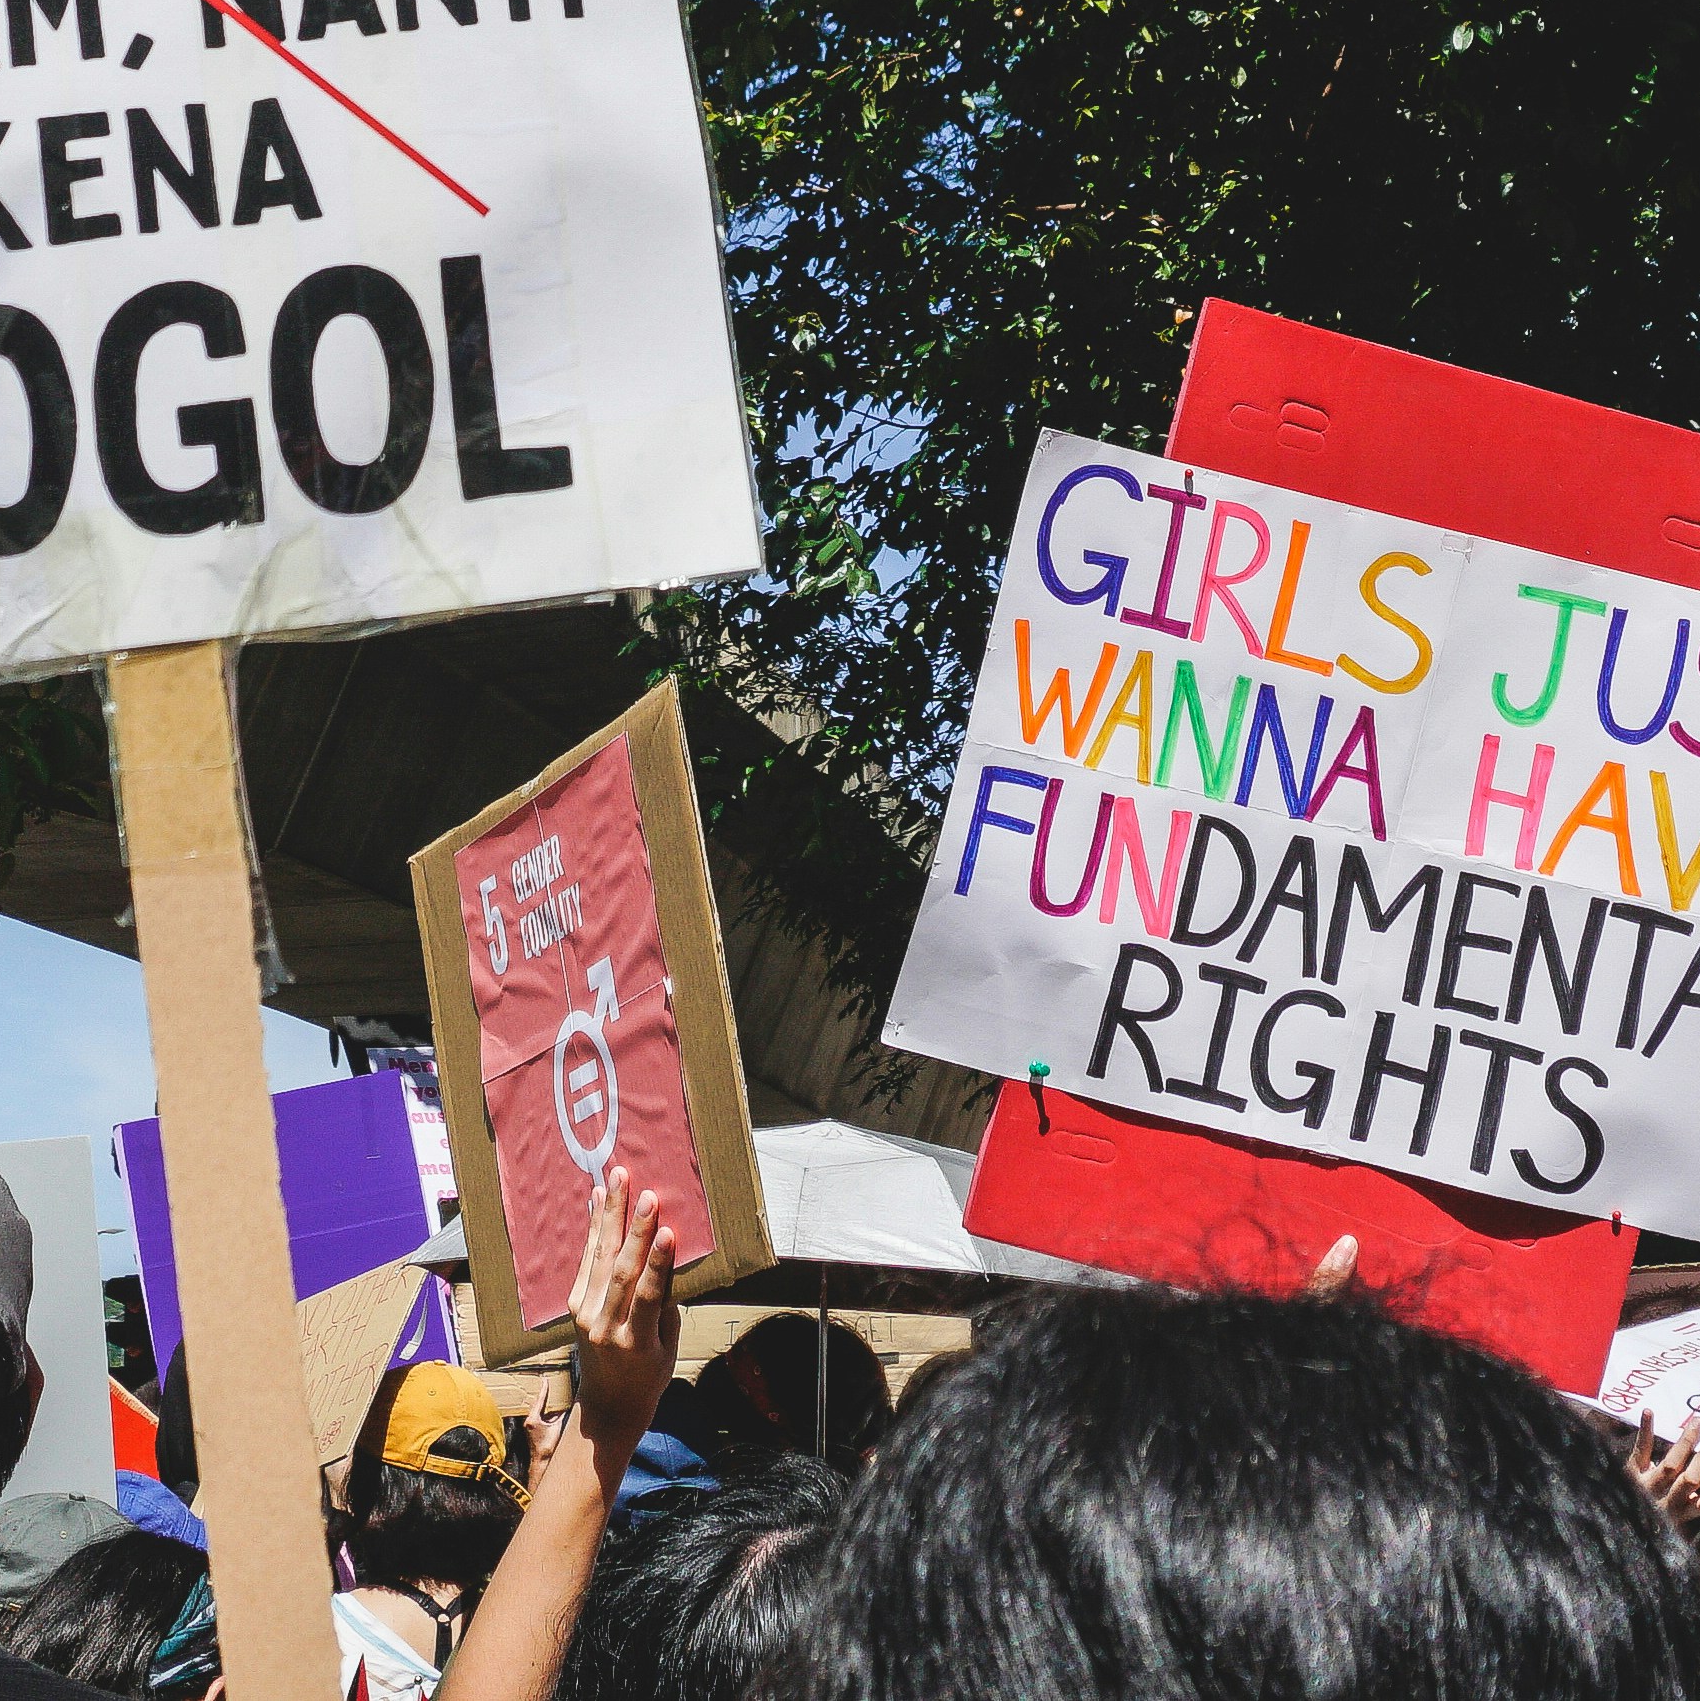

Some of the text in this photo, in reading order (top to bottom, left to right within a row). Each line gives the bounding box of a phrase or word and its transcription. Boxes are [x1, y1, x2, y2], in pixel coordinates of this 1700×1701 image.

[1035, 464, 1434, 696] GIRLS
[1013, 618, 1387, 842] WANNA
[479, 874, 510, 976] 5
[511, 834, 565, 904] GENDER
[519, 881, 584, 961] EQUALITY
[1086, 944, 1610, 1195] RIGHTS
